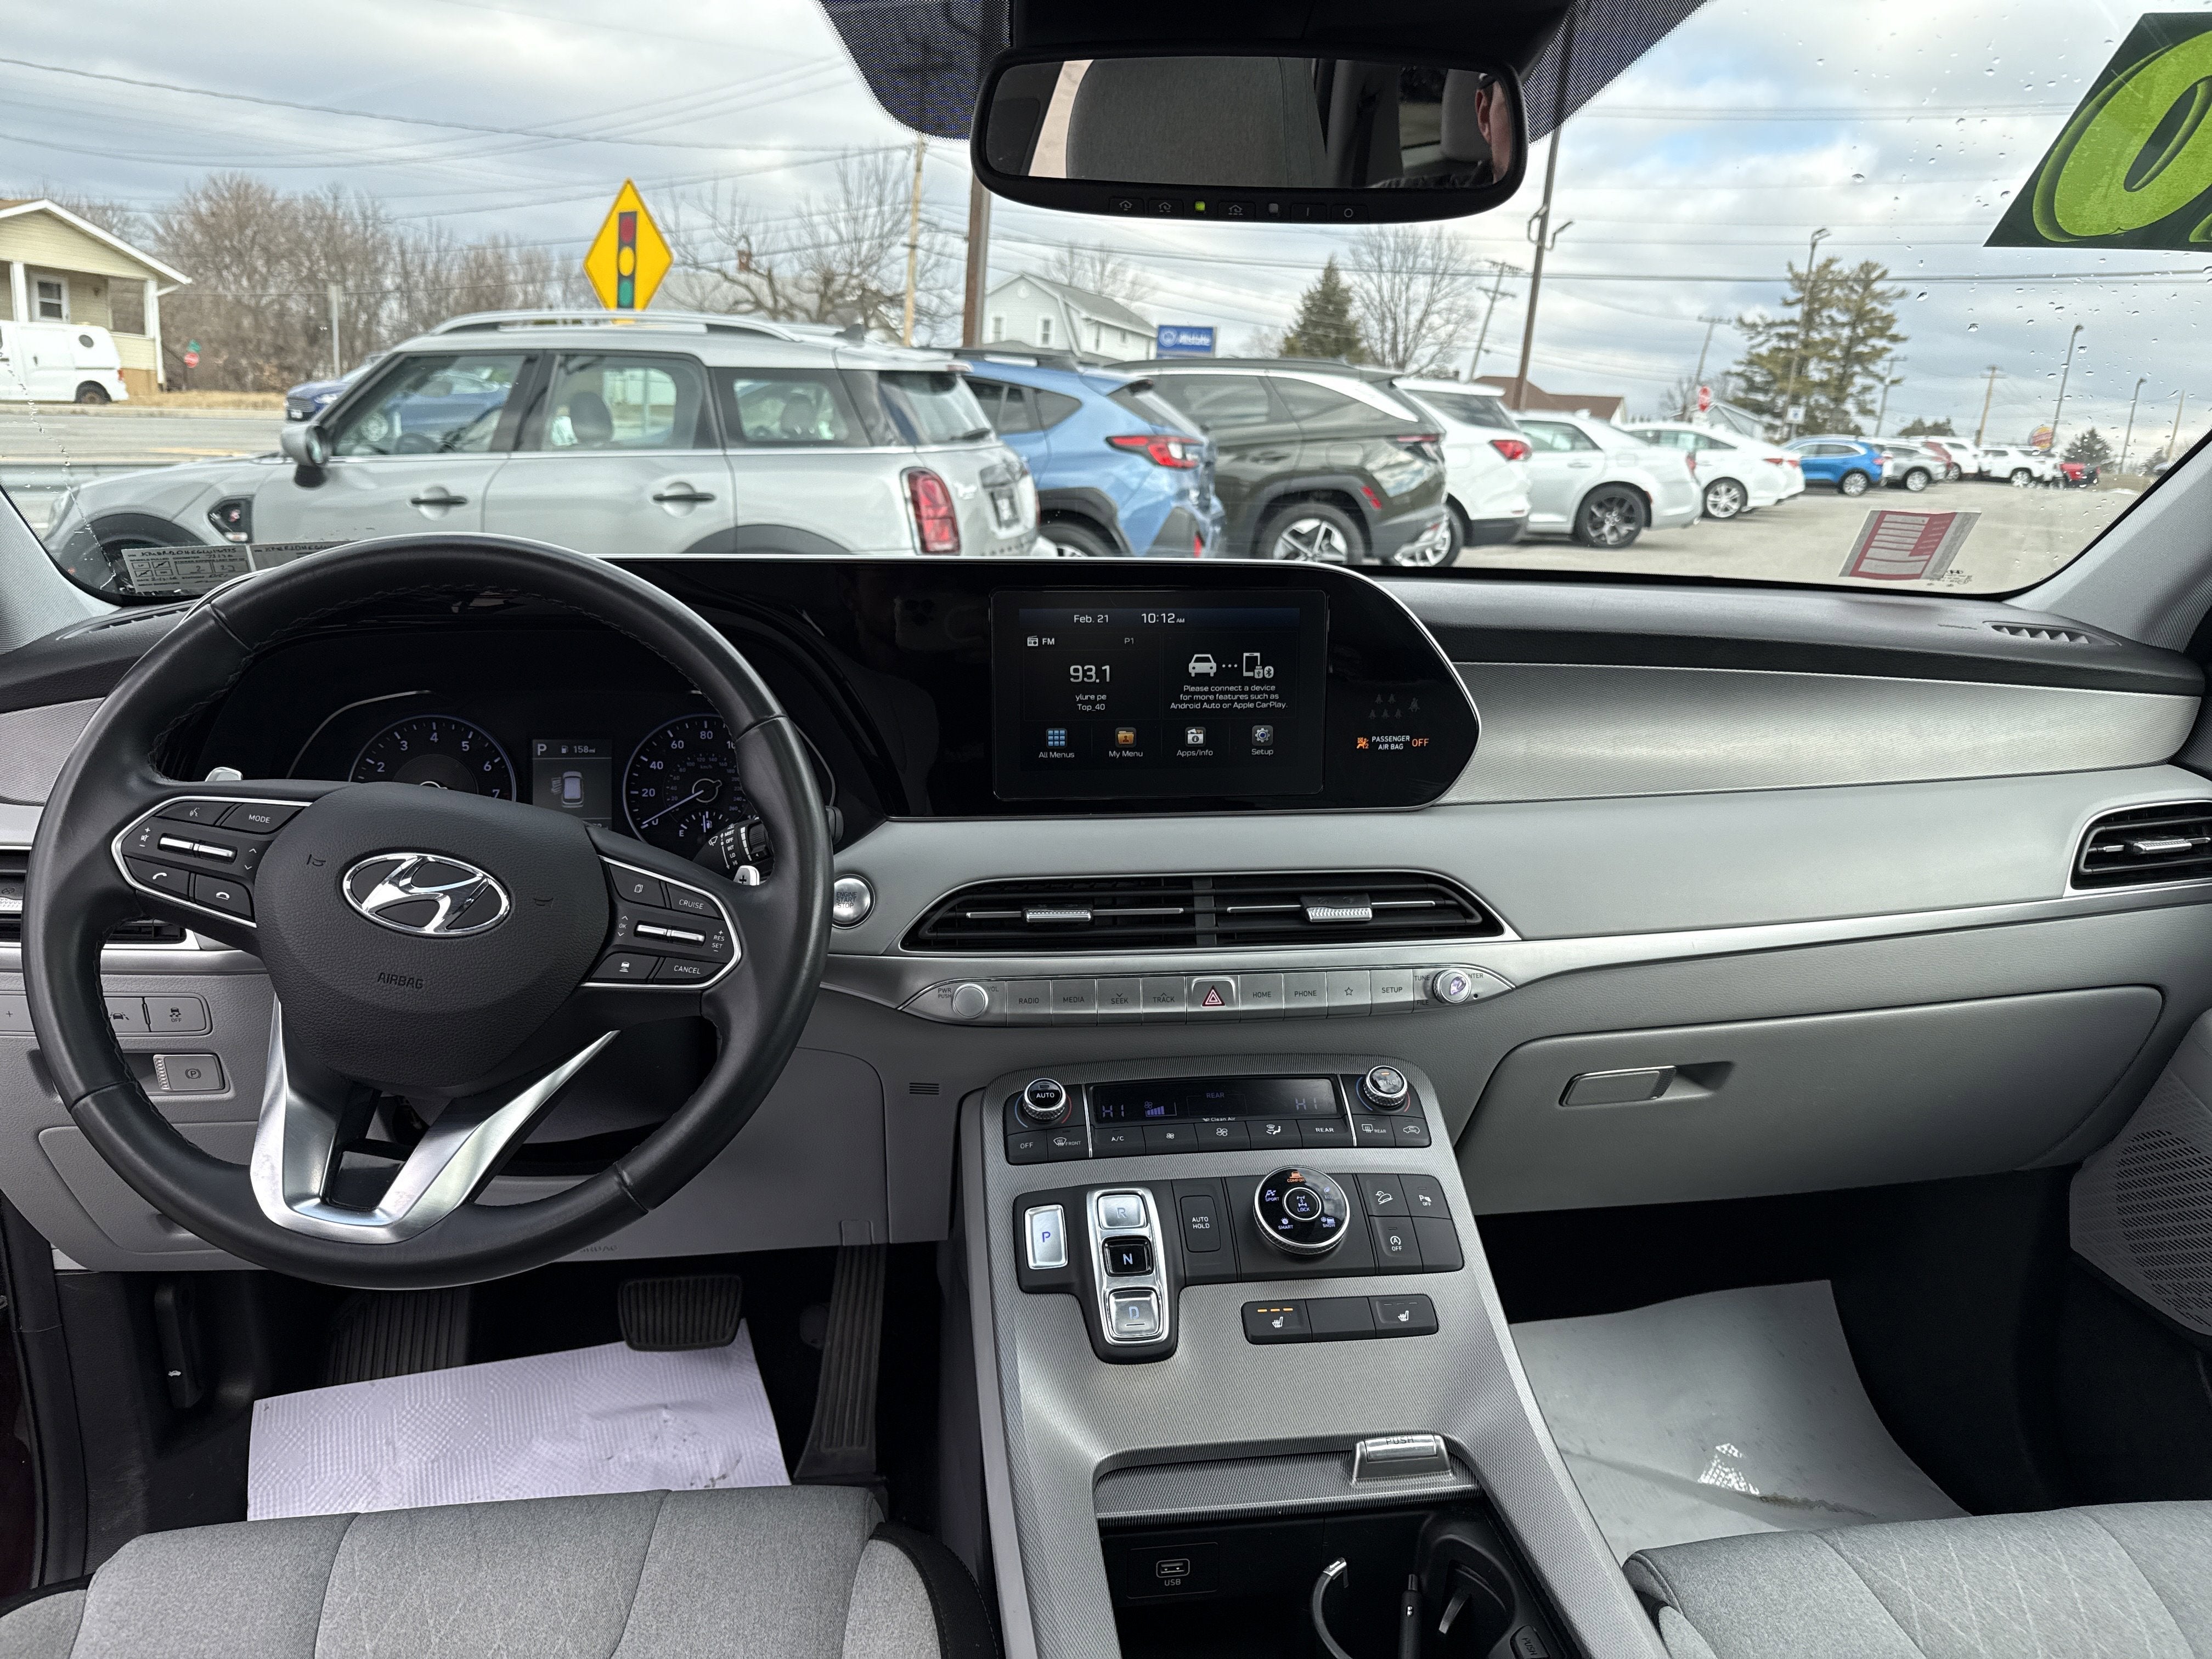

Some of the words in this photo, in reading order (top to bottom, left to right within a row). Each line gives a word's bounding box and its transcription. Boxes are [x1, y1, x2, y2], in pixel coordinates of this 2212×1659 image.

[1074, 614, 1095, 623] Feb.
[1097, 614, 1109, 623] 21
[1141, 613, 1175, 623] 10:12
[1042, 637, 1055, 646] FM
[1070, 665, 1110, 682] 93.1
[1077, 703, 1105, 712] Top_40
[1256, 701, 1288, 709] CarPlay.
[430, 732, 439, 743] 4
[699, 730, 713, 740] 80
[400, 740, 408, 751] 3
[461, 741, 470, 752] 5
[671, 740, 685, 749] 60
[1412, 738, 1430, 747] OFF
[537, 743, 547, 756] P
[1109, 751, 1120, 759] My
[377, 761, 385, 772] 2
[483, 761, 492, 771] 6
[650, 761, 664, 770] 40
[492, 789, 500, 799] 7
[641, 788, 656, 797] 20
[248, 814, 271, 824] MODE
[679, 899, 704, 910] CRUISE
[674, 964, 702, 975] CANCEL
[377, 972, 424, 990] AIRBAG
[1018, 997, 1040, 1005] RADIO
[1019, 1141, 1034, 1149] OFF
[1116, 1207, 1127, 1219] R
[1042, 1231, 1051, 1243] P
[1122, 1253, 1133, 1265] N
[1128, 1306, 1139, 1320] D
[1385, 1436, 1414, 1445] PUSH
[1164, 1577, 1182, 1587] USB
